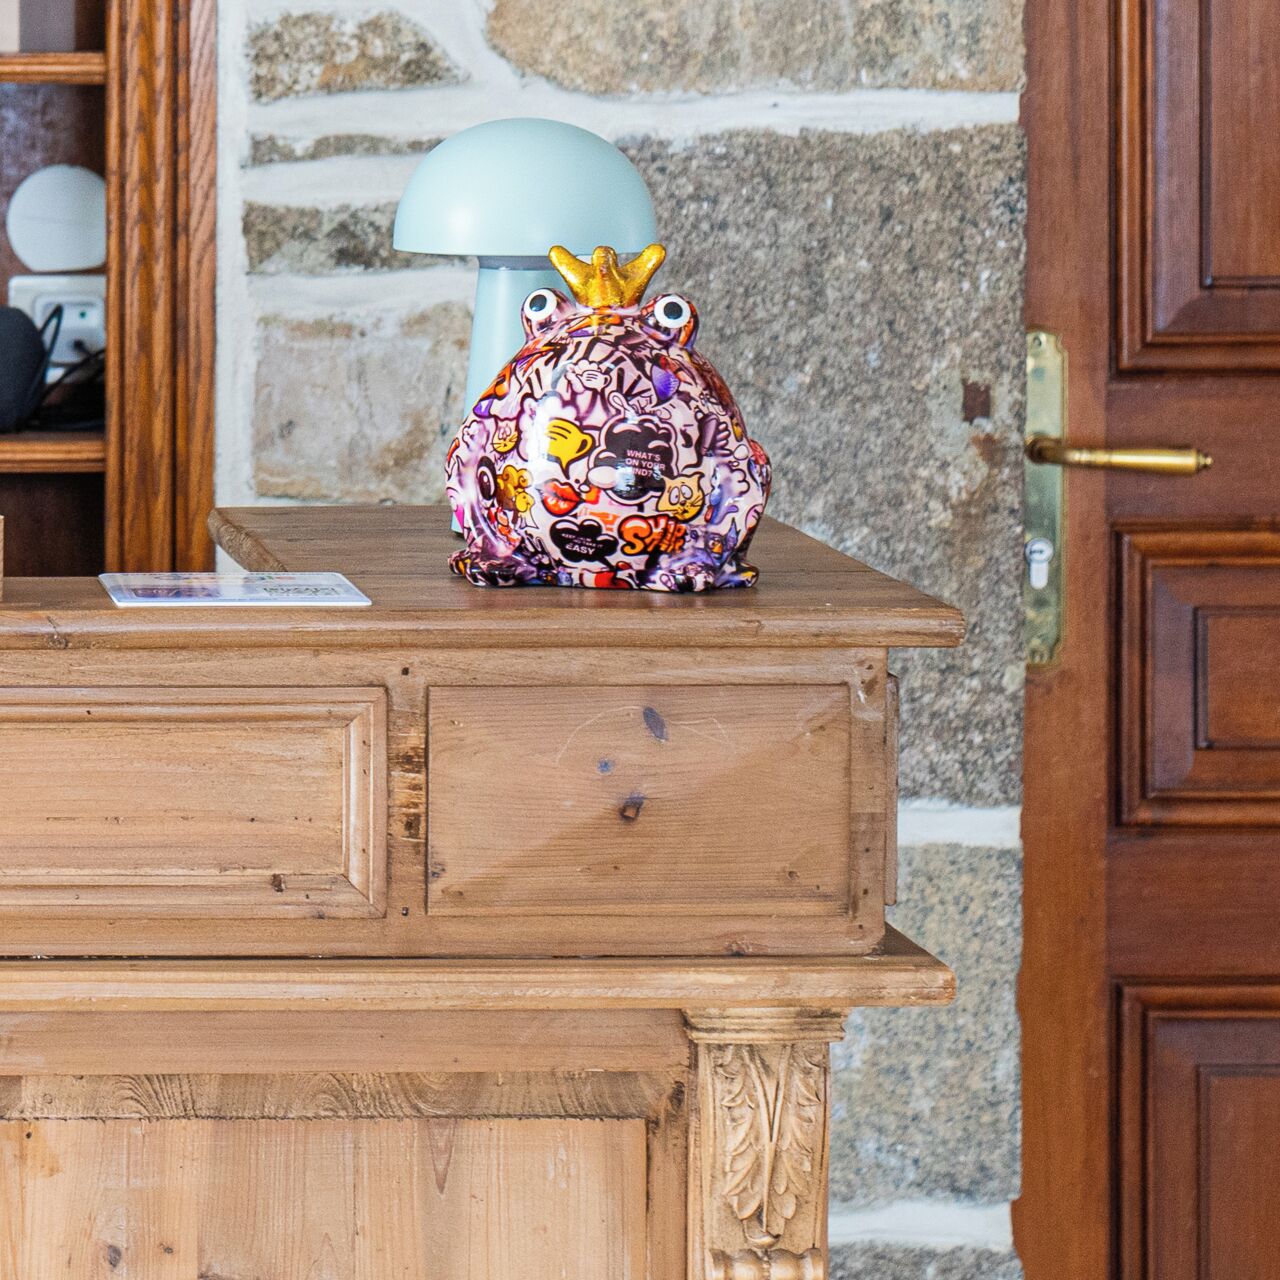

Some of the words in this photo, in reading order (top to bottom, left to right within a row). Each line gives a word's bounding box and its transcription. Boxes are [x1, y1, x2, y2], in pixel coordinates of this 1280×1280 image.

[625, 458, 640, 466] ON
[626, 450, 661, 462] WHAT'S
[565, 542, 596, 556] EASY
